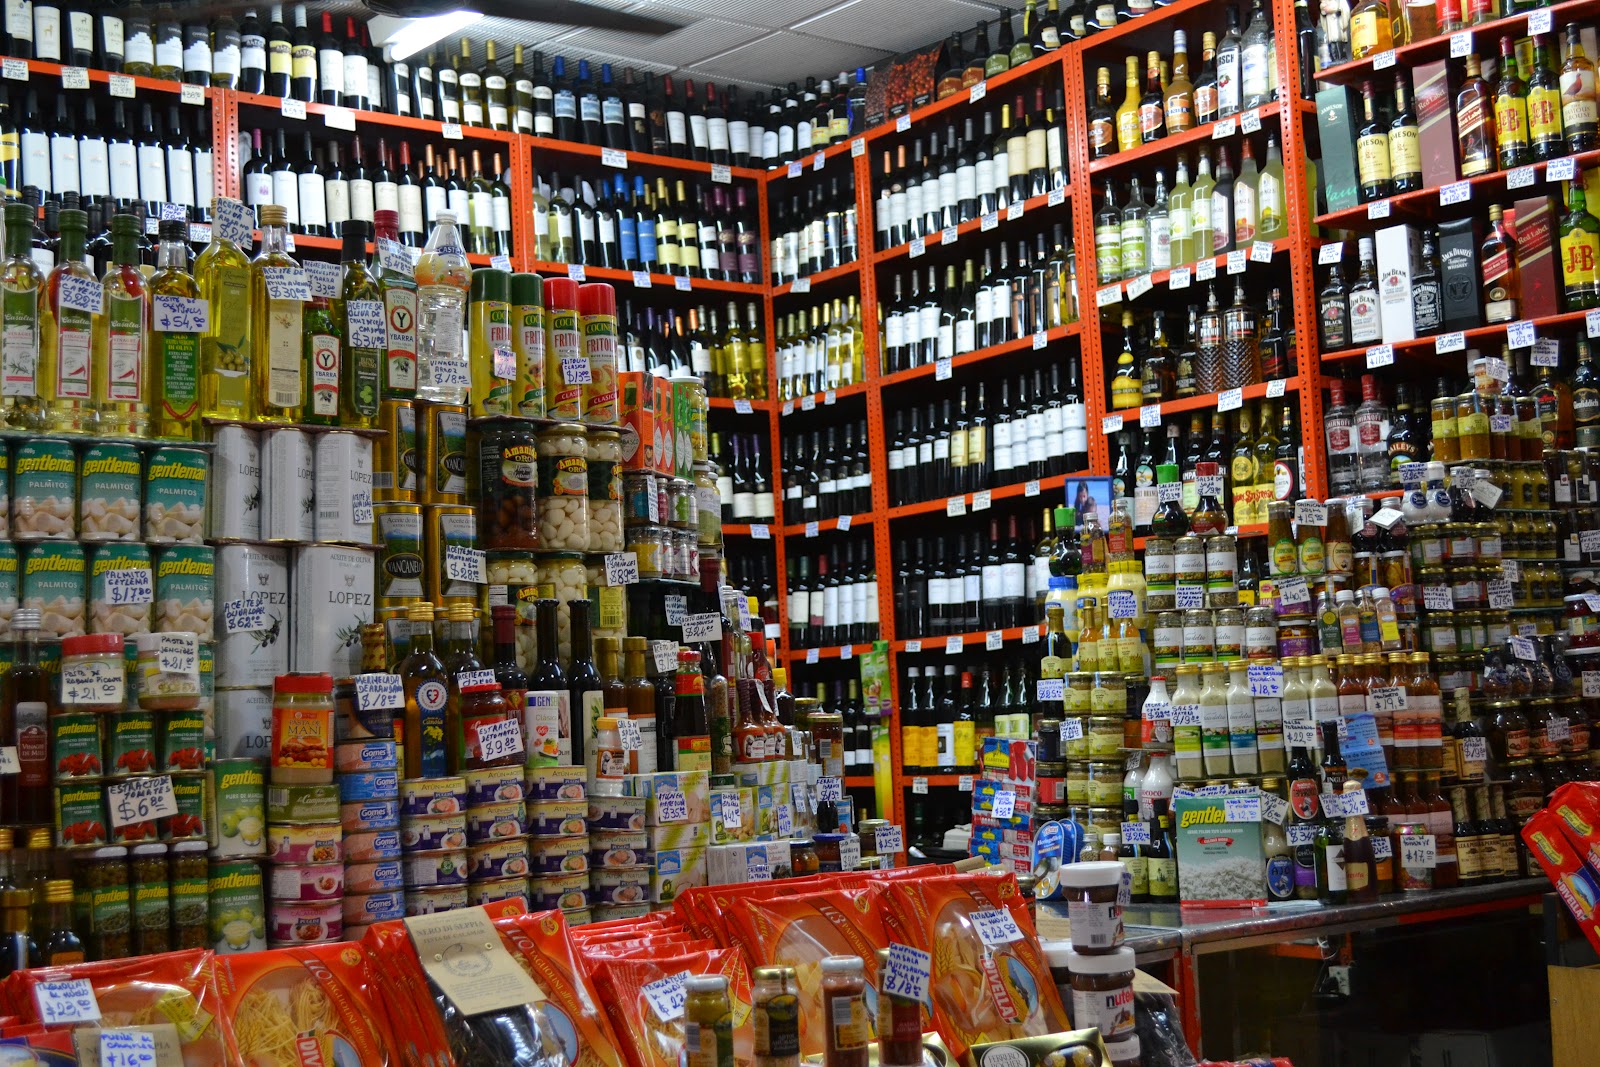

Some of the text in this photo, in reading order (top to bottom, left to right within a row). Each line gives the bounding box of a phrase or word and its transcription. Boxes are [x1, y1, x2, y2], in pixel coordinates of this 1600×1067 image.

[1320, 104, 1343, 115] JAMESON
[217, 198, 255, 219] ACEITE DE
[1518, 224, 1550, 246] Red Label
[1441, 250, 1453, 263] JACK
[1565, 244, 1595, 274] J&B
[262, 267, 304, 276] ACEITE DE
[1381, 268, 1407, 282] JIM BEAM
[60, 273, 101, 291] VINAGRE
[1360, 294, 1376, 305] BEAM
[1324, 319, 1343, 327] BLACK
[389, 332, 414, 343] YBARRA
[315, 370, 337, 379] YBARRA
[15, 454, 75, 474] gentleman
[82, 456, 141, 477] gentleman
[148, 461, 206, 481] gentleman
[239, 463, 260, 478] LOPE
[350, 469, 372, 484] LOPEZ
[28, 481, 69, 489] PALMITOS
[95, 481, 134, 491] PALMITOS
[158, 487, 197, 497] PALMITOS
[25, 554, 85, 574] gentleman
[329, 553, 348, 562] ACEITE
[105, 570, 147, 579] PALMITO
[158, 558, 214, 577] gentleman
[37, 581, 78, 589] PALMITOS
[169, 583, 208, 591] PALMITOS
[328, 590, 372, 606] LOPEZ
[224, 599, 255, 612] ACEITE
[57, 722, 97, 737] gentleman
[246, 735, 272, 749] LOP
[361, 748, 387, 758] Gomes
[220, 769, 264, 789] gentlem
[375, 778, 397, 787] Gomes
[360, 807, 387, 817] Gomes
[1180, 805, 1227, 829] gentle
[375, 837, 397, 847] Gomes
[375, 868, 398, 878] Gomes
[1271, 866, 1291, 876] AJO
[208, 872, 262, 893] gentleman
[365, 899, 393, 910] Gomes
[1558, 883, 1584, 921] DIVELLA
[416, 926, 443, 938] NERO
[455, 919, 486, 931] SEPPIA
[841, 920, 878, 969] PAPPARDELLE
[889, 951, 919, 966] MASALA
[528, 949, 567, 992] TAGLIOLINI
[982, 959, 1014, 1019] DIVELLA
[326, 979, 358, 1028] TAGLIOLINI
[988, 1052, 1020, 1064] FERRERO
